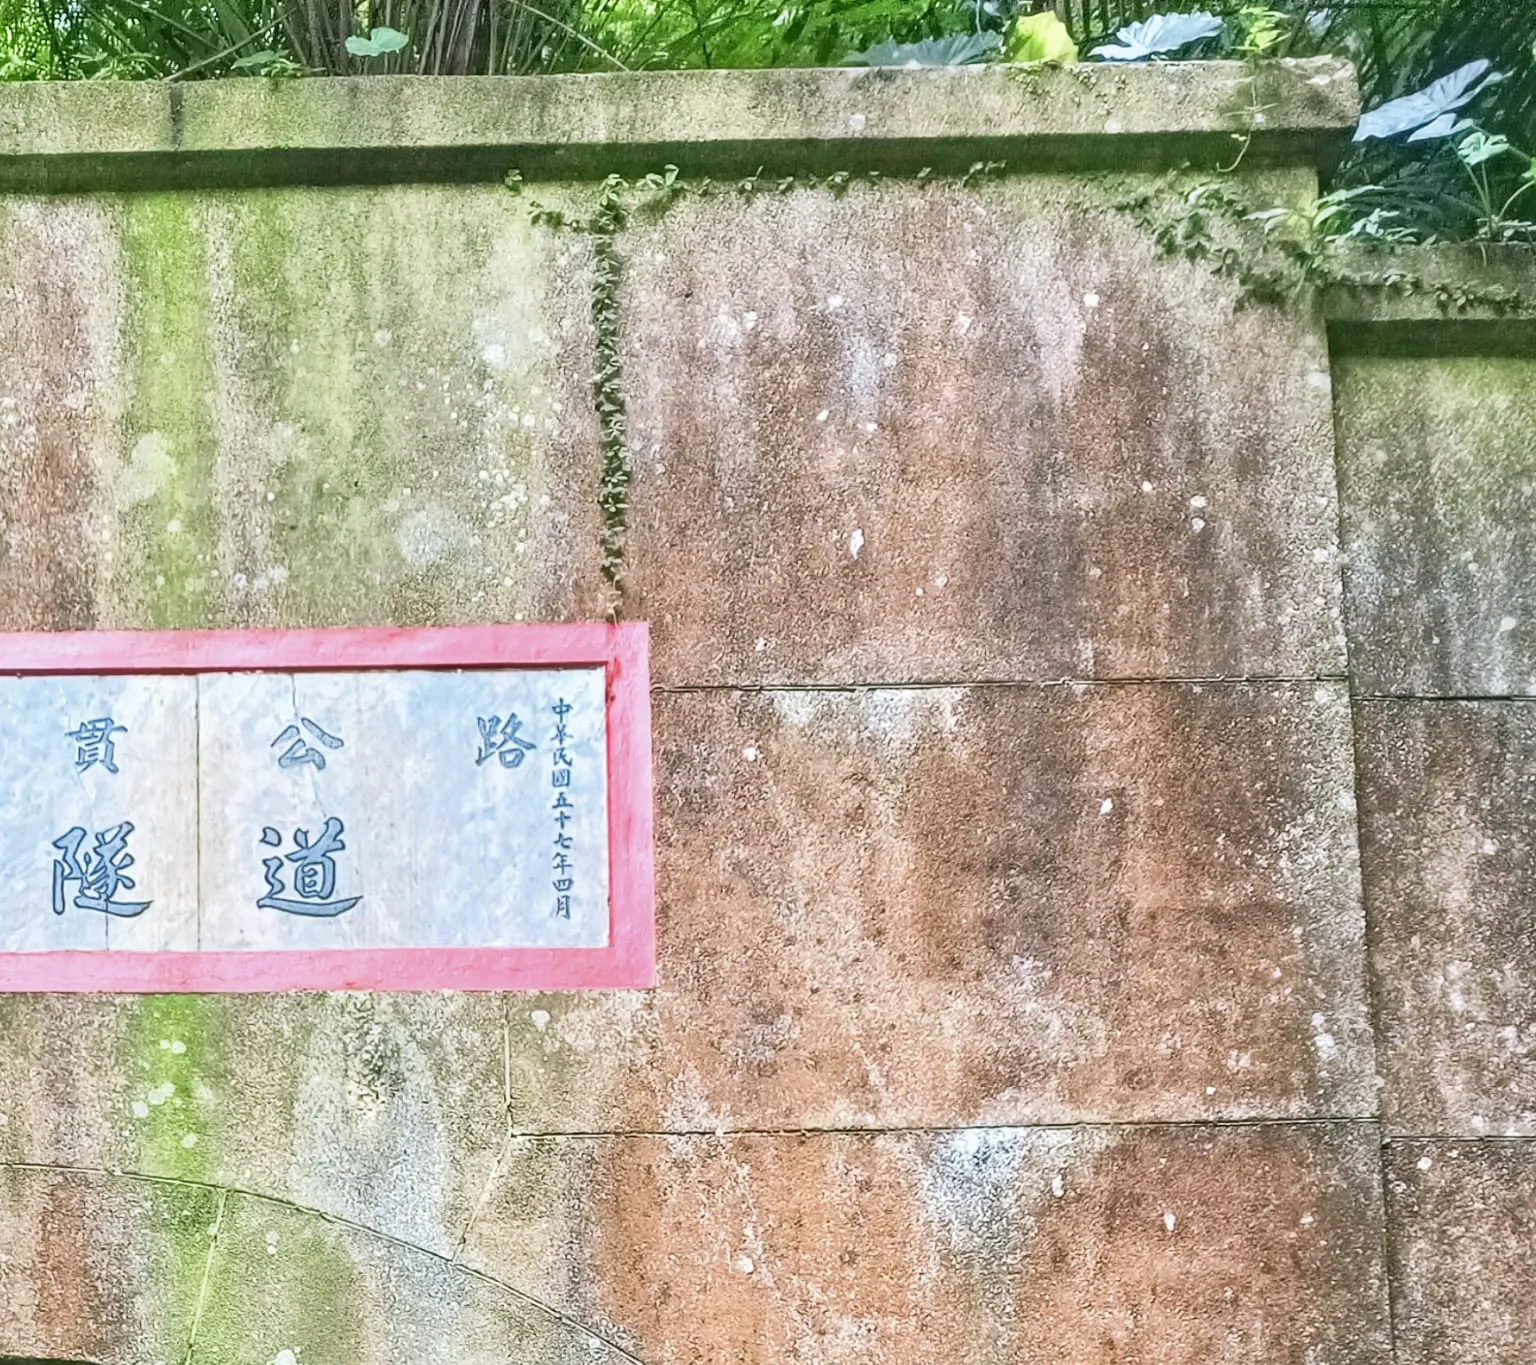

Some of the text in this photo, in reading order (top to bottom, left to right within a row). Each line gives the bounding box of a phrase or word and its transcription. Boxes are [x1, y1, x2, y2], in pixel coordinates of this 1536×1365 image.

[551, 697, 574, 920] 中華民國五十七年四月
